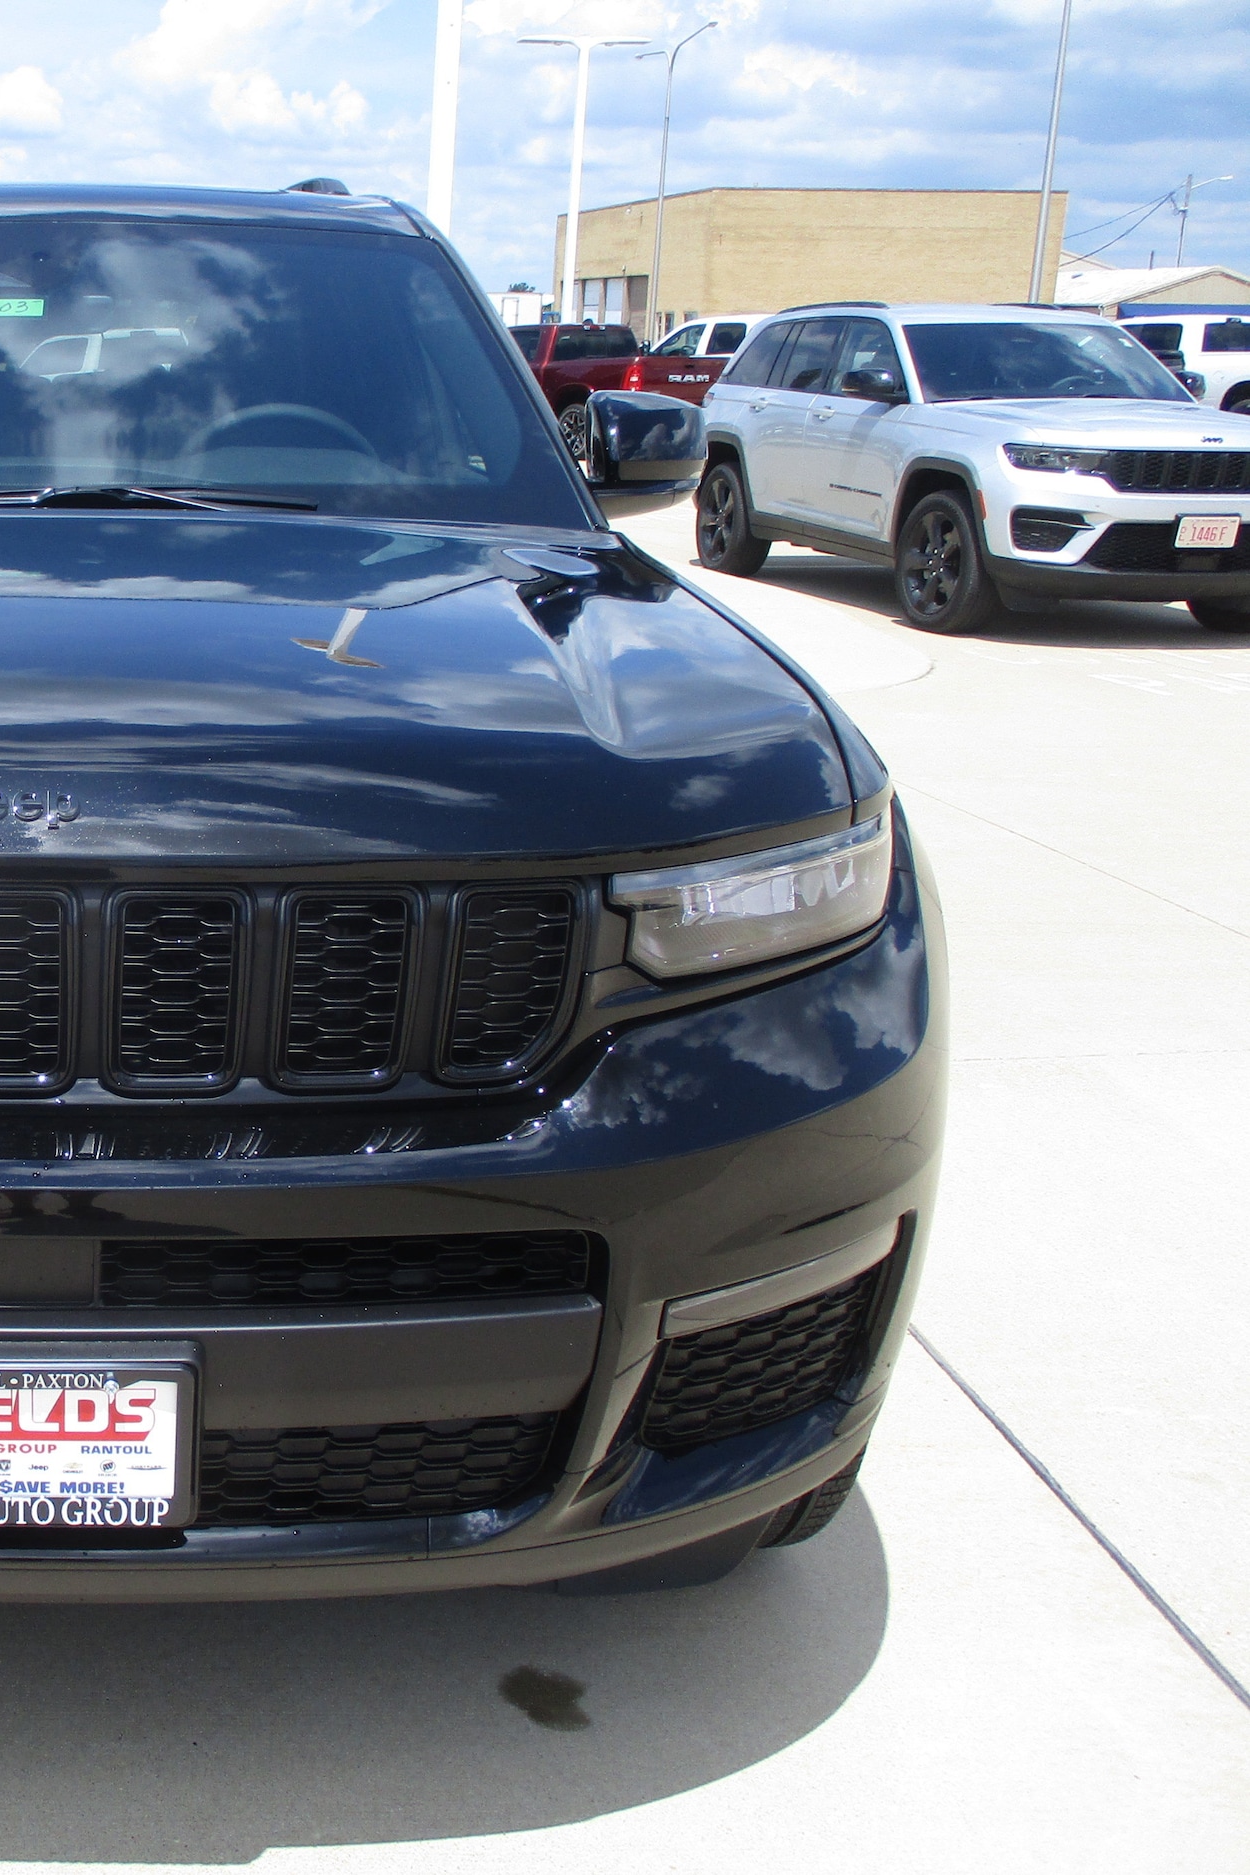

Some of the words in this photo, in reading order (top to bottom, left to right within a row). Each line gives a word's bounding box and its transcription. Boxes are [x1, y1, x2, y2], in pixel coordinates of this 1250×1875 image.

[668, 374, 710, 383] RAM
[21, 1372, 104, 1390] PAXTON
[80, 1445, 152, 1455] RANTOUL
[0, 1480, 51, 1494] $AVE
[59, 1481, 125, 1494] MORE!
[61, 1496, 170, 1527] GROUP
